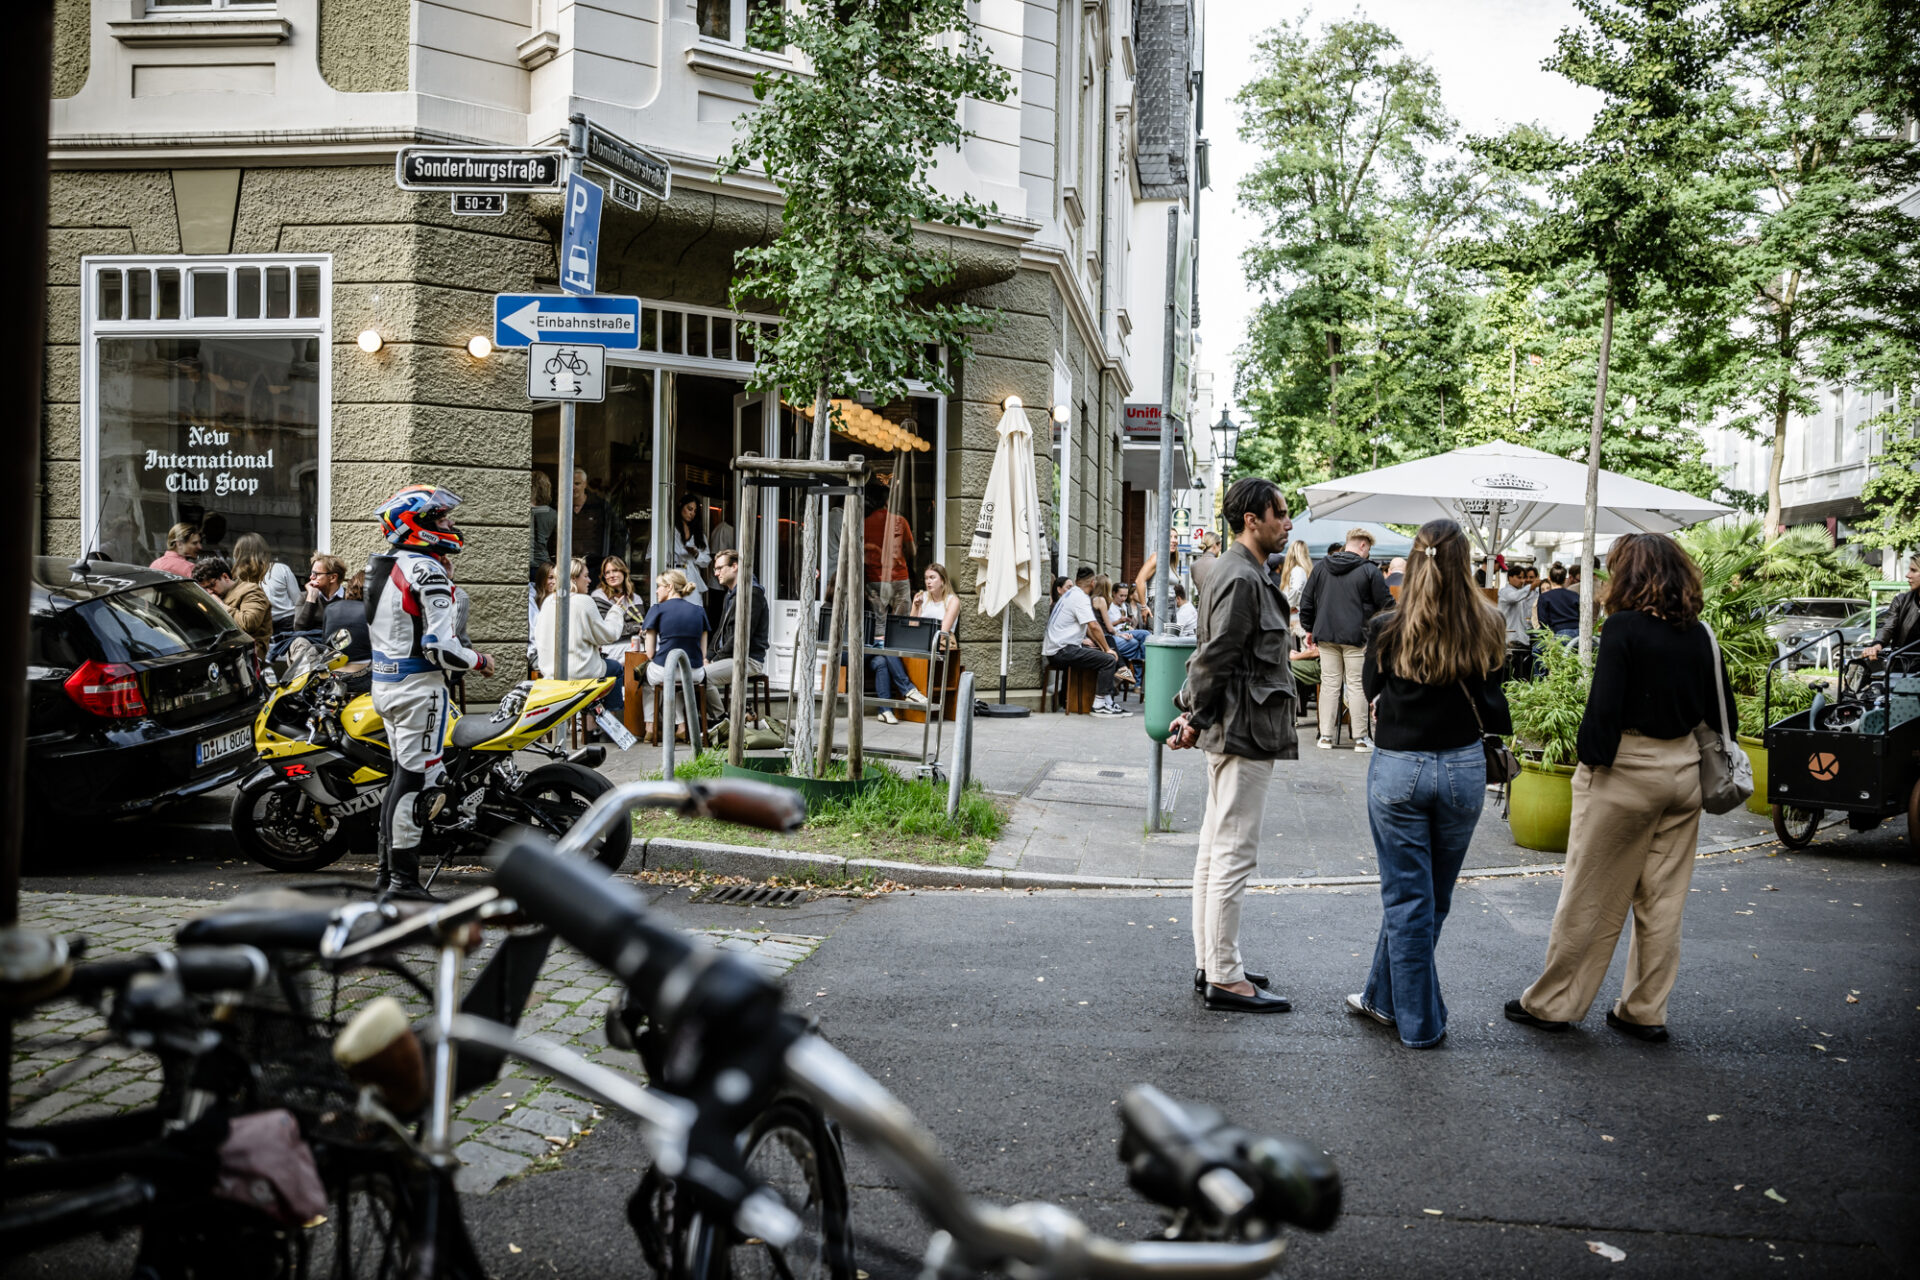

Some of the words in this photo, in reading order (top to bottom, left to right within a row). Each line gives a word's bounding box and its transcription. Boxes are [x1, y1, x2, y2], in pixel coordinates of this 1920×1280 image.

[414, 158, 546, 182] Sonderburgstraße
[592, 135, 665, 187] Dominikanerstraße
[464, 197, 493, 210] 50-2
[618, 186, 635, 203] 16-14
[570, 184, 588, 228] P
[536, 316, 631, 330] Einbahnstraße
[188, 426, 230, 448] New
[144, 449, 274, 471] International
[165, 472, 209, 493] Club
[215, 472, 259, 496] Stop
[421, 531, 438, 542] SHOEI
[422, 690, 438, 753] Held
[203, 744, 210, 760] D
